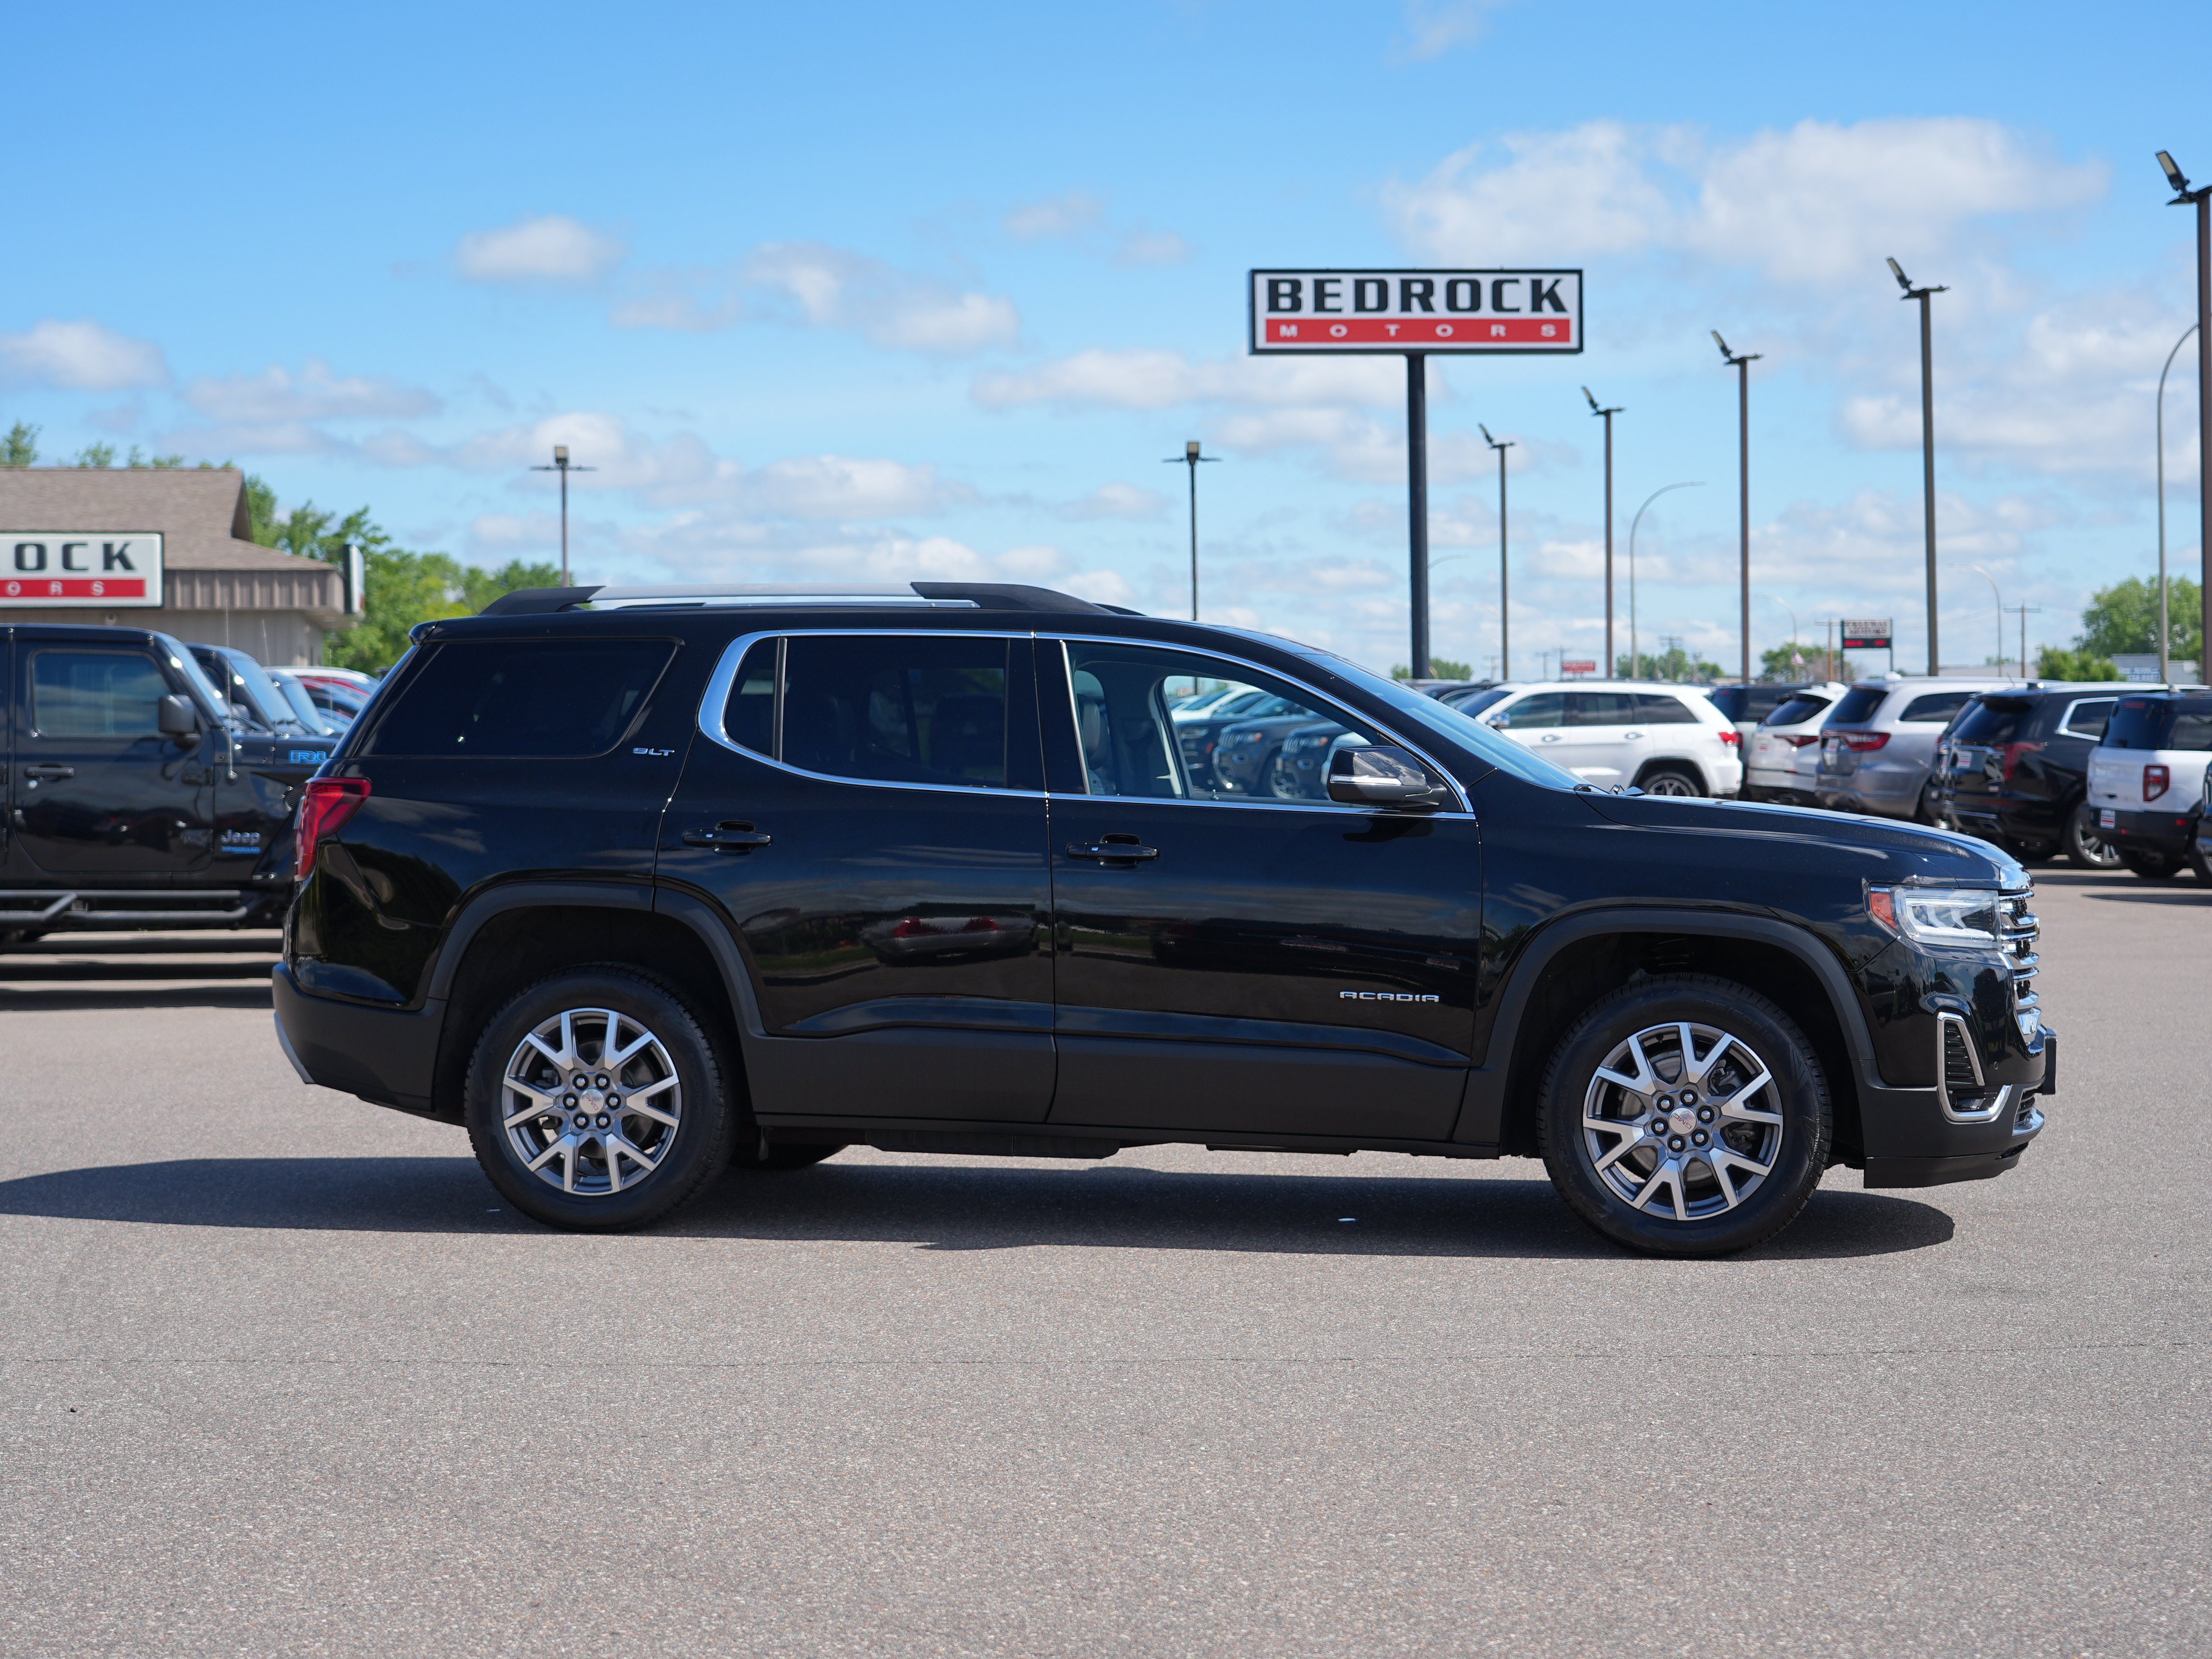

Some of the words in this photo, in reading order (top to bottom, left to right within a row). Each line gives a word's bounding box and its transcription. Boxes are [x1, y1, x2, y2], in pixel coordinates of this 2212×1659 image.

[1267, 279, 1567, 313] BEDROCK
[1279, 324, 1557, 338] MOTORS
[633, 747, 675, 756] SLT
[220, 829, 261, 845] Jeep
[1339, 991, 1439, 1002] ACADIA
[584, 1092, 599, 1110] GMC
[1673, 1112, 1692, 1129] GMC
